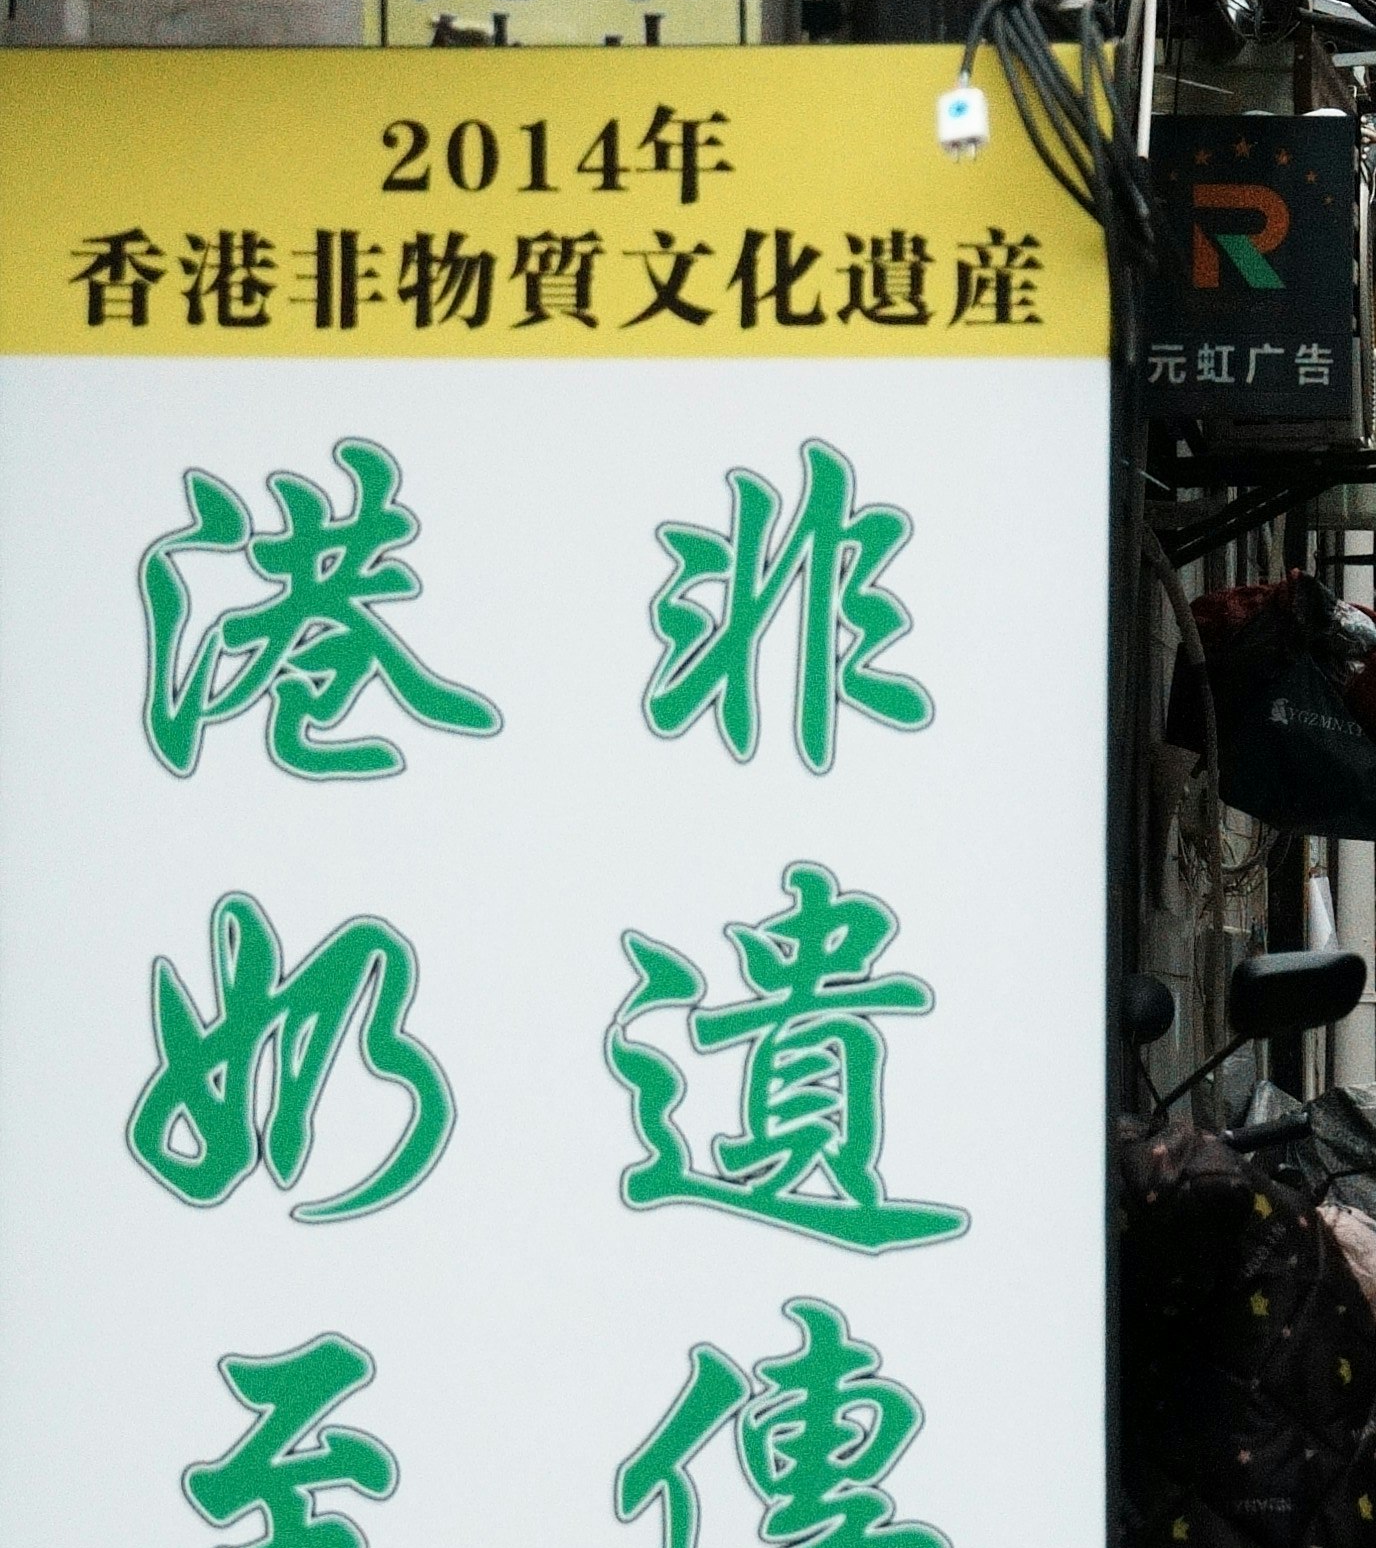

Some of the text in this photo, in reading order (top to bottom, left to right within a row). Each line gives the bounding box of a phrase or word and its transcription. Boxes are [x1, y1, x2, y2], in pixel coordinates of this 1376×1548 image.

[380, 104, 736, 206] 2014年
[68, 226, 1045, 332] 香港非物質文化遺産
[1147, 342, 1335, 386] 元虹广告
